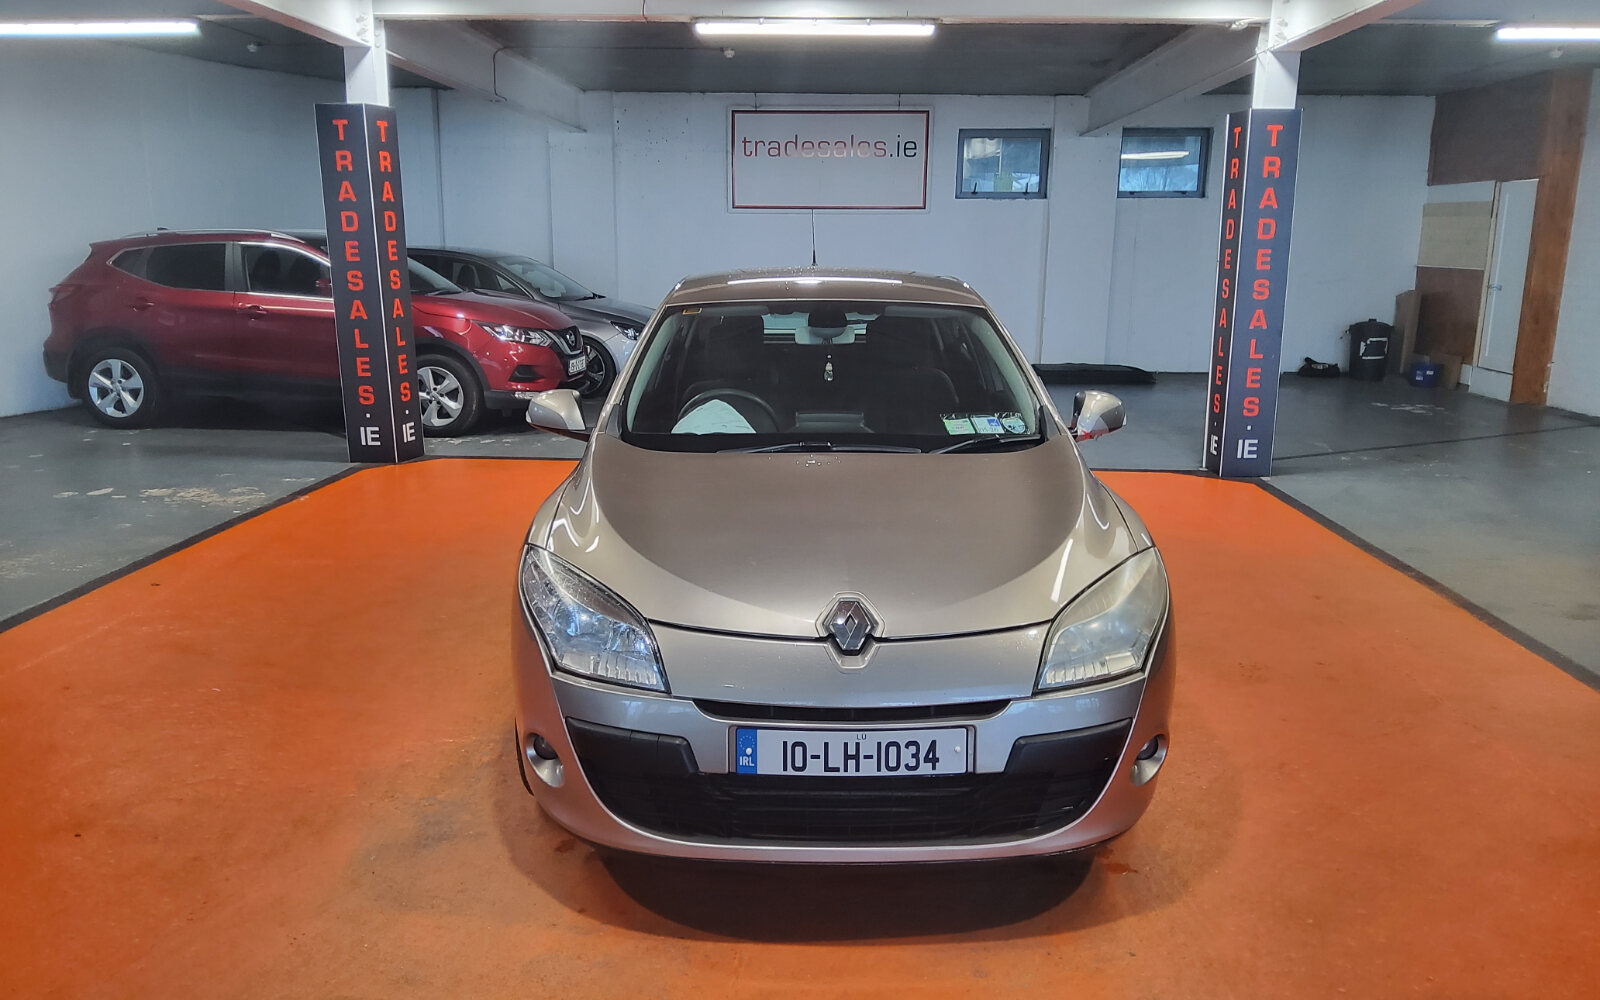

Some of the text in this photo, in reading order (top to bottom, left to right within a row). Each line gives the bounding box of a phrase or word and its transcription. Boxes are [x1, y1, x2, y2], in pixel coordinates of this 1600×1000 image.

[742, 134, 918, 158] tradesales.ie
[739, 756, 755, 767] IRL
[782, 740, 940, 773] 10-LH-1034
